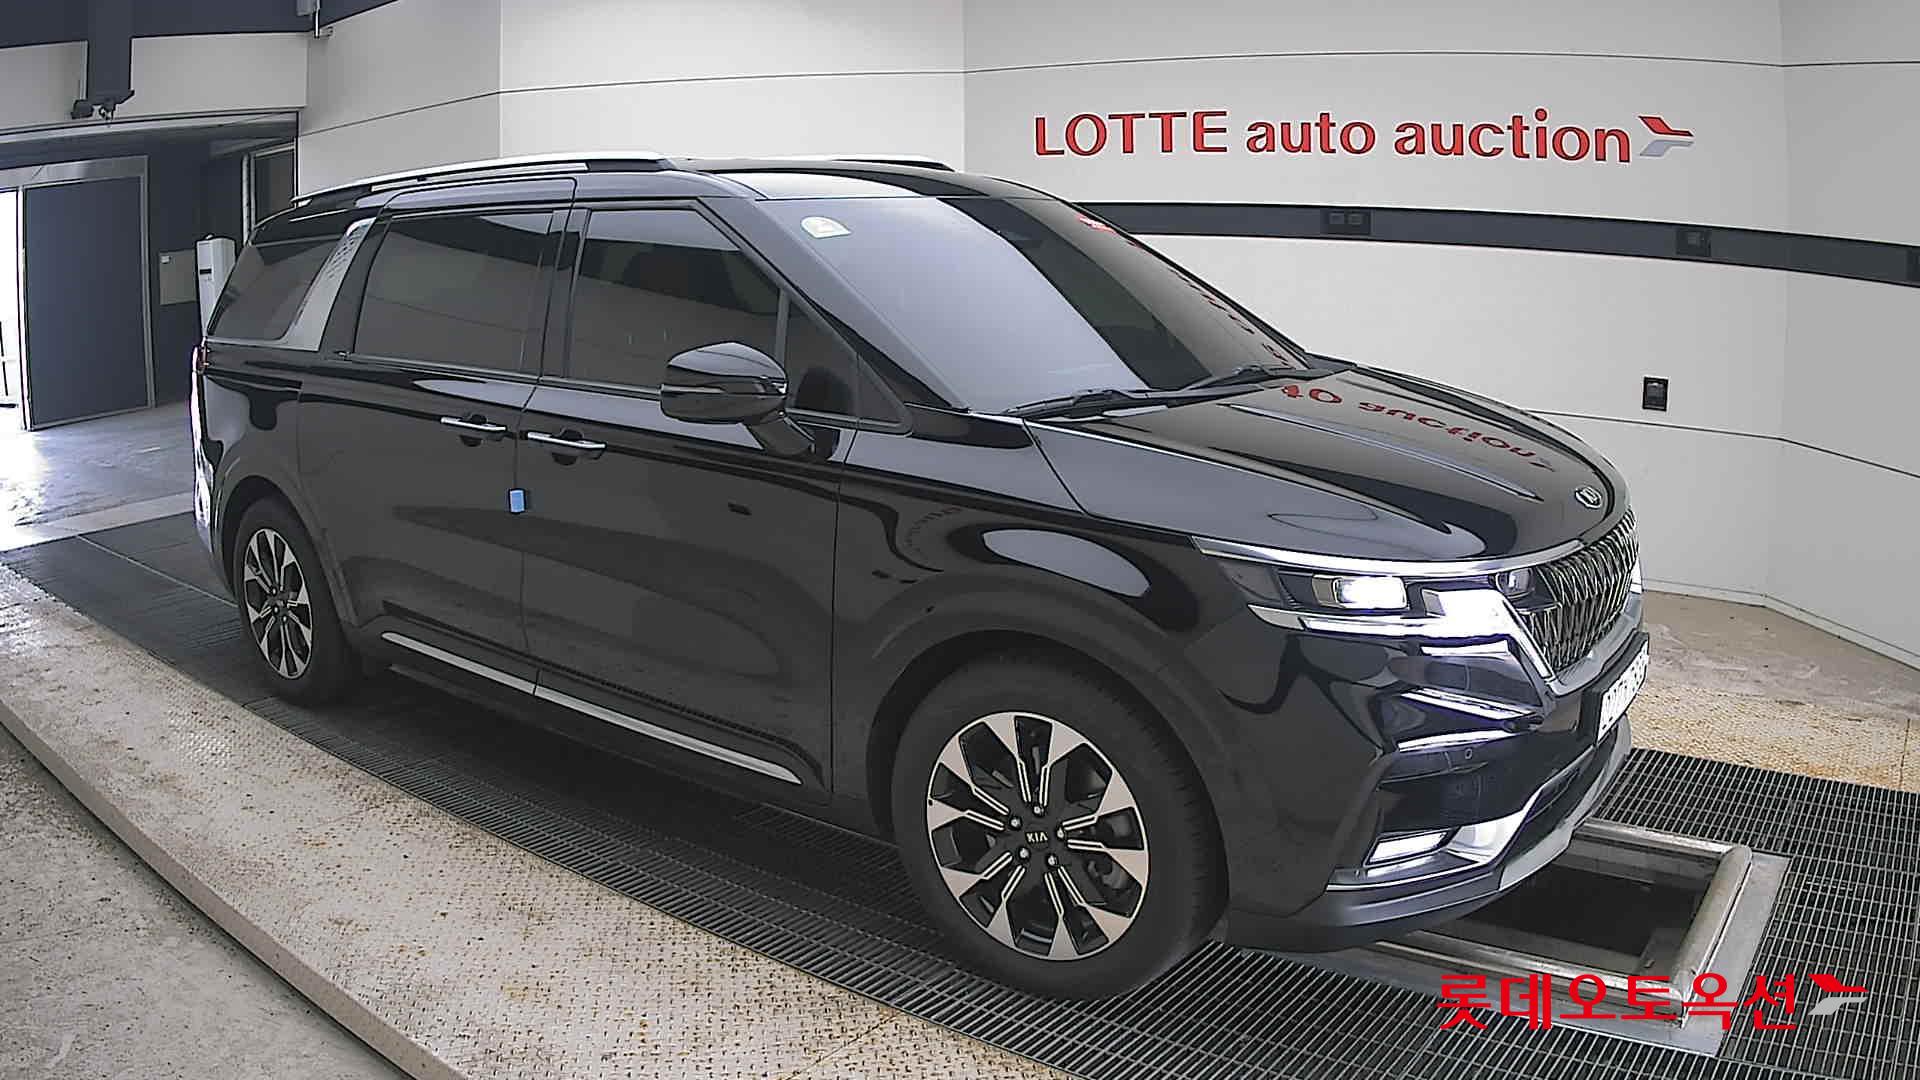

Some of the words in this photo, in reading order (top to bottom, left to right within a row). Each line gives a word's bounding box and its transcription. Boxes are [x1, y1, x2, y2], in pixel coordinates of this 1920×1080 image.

[1034, 110, 1228, 156] LOTTE
[1245, 112, 1376, 155] auto
[1393, 107, 1632, 163] auction
[1026, 831, 1049, 843] KIA
